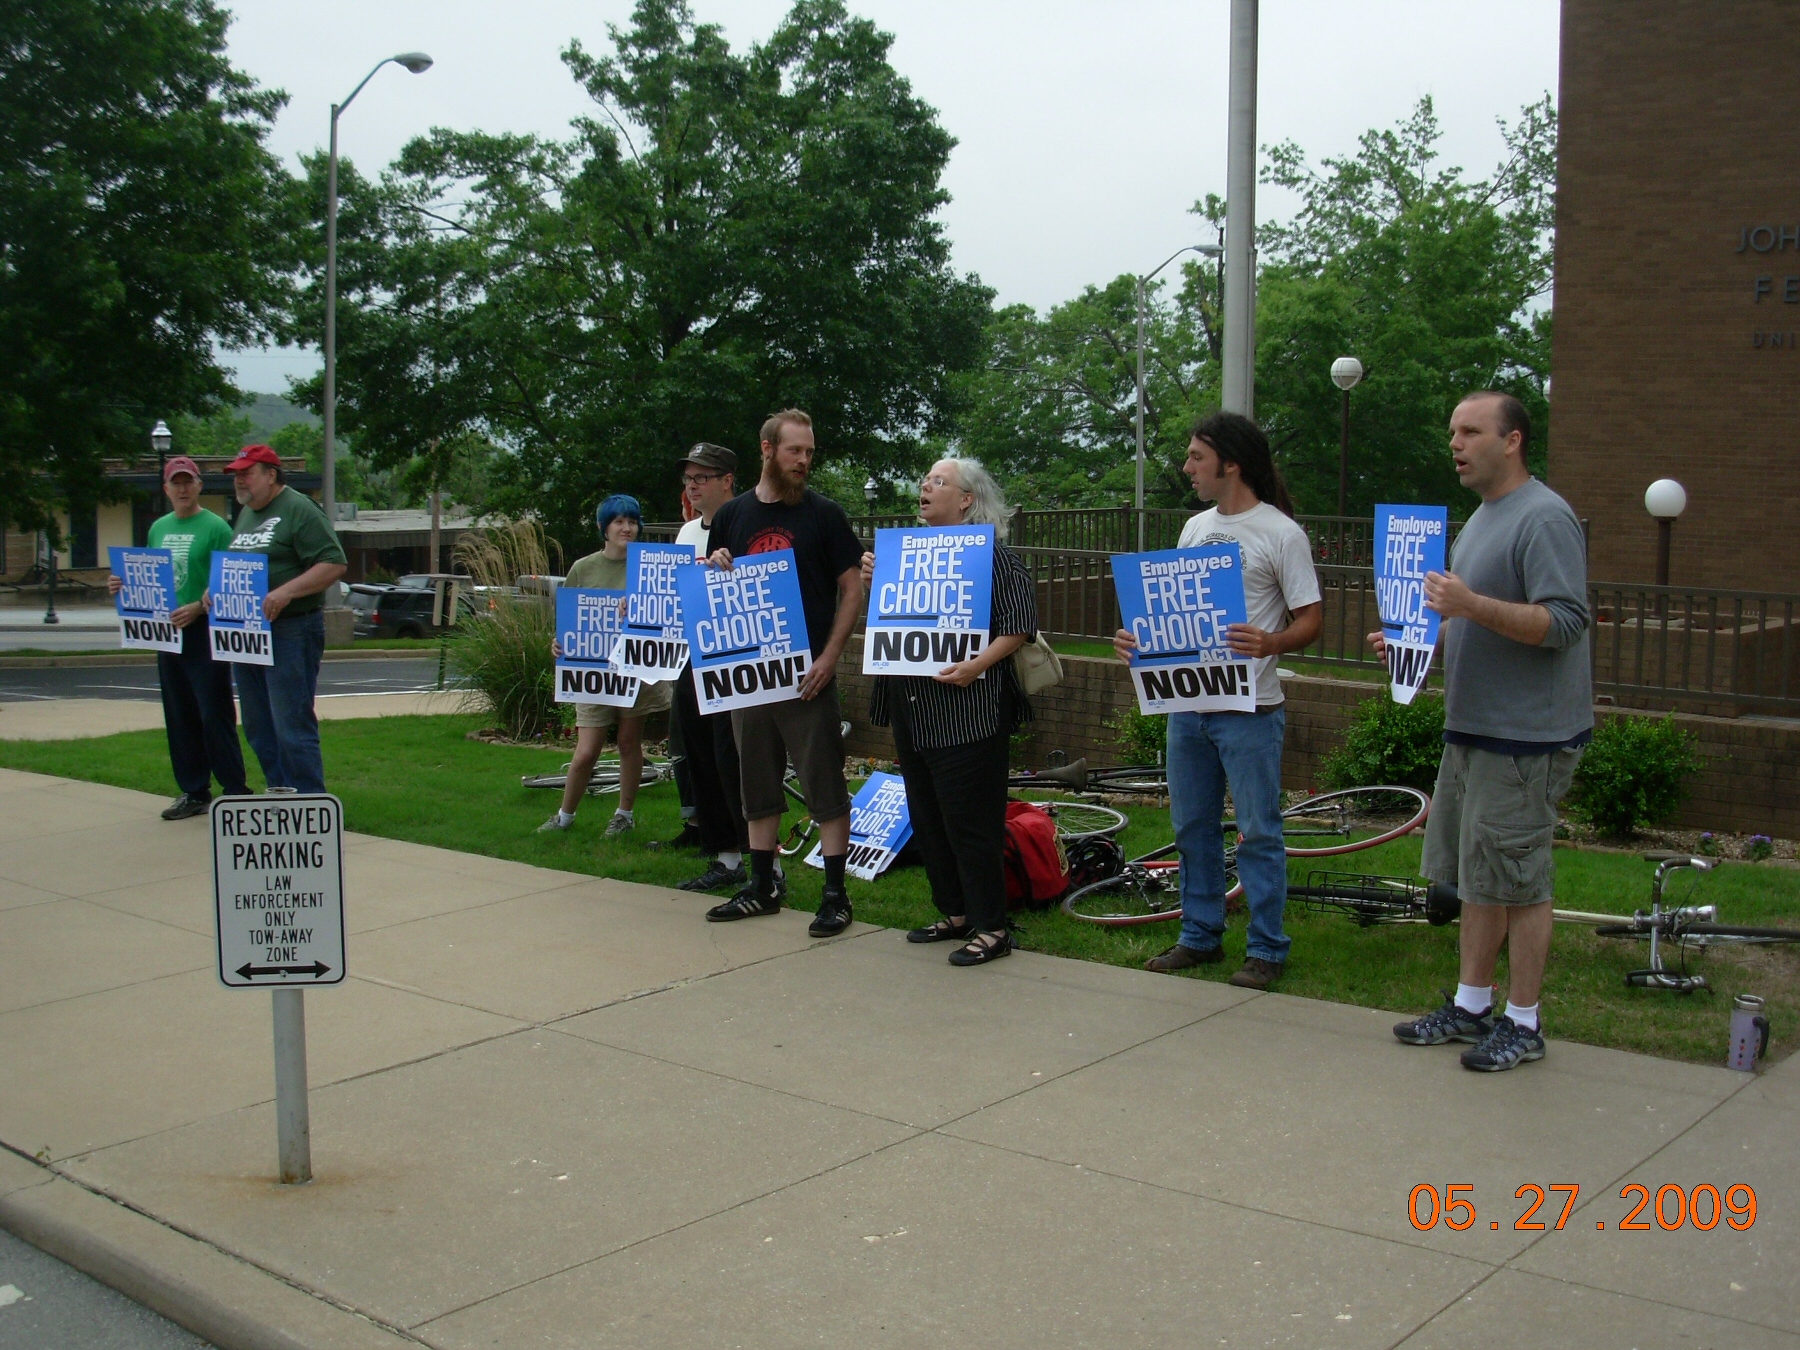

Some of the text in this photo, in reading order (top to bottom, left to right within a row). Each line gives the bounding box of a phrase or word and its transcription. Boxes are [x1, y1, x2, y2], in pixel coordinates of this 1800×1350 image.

[232, 531, 275, 546] AFSCME
[1387, 515, 1442, 538] Employee
[902, 533, 987, 550] Employee
[122, 552, 169, 566] Employee
[222, 557, 264, 571] Employee
[640, 550, 691, 567] Employee
[899, 547, 965, 581] FREE
[1139, 555, 1233, 578] Employee
[1384, 534, 1427, 579] FREE
[124, 563, 161, 587] FREE
[221, 568, 255, 595] FREE
[638, 563, 677, 595] FREE
[704, 559, 789, 584] Employee
[120, 584, 170, 611] CHOICE
[578, 594, 622, 608] Emplo
[706, 575, 774, 617] FREE
[878, 580, 974, 615] CHOICE
[1142, 571, 1214, 615] FREE
[1377, 576, 1429, 626] CHOICE
[213, 593, 262, 620] CHOICE
[627, 593, 684, 626] CHOICE
[123, 619, 179, 643] NOW!
[244, 620, 263, 631] ACT
[661, 626, 684, 639] ACT
[696, 607, 791, 653] CHOICE
[936, 615, 973, 629] ACT
[1132, 609, 1228, 653] CHOICE
[214, 629, 269, 655] NOW!
[872, 631, 982, 663] NOW!
[1401, 625, 1428, 645] ACT
[624, 639, 689, 669] NOW!
[760, 640, 792, 658] ACT
[1199, 649, 1235, 663] ACT
[561, 669, 637, 697] NOW!
[702, 655, 806, 701] NOW!
[1139, 664, 1250, 701] NOW!
[865, 788, 907, 815] FREE
[222, 807, 332, 836] RESERVED
[865, 835, 888, 847] ACT
[233, 841, 324, 870] PARKING
[265, 875, 292, 891] LAW
[235, 892, 324, 910] ENFORCEMENT
[265, 911, 296, 927] ONLY
[249, 928, 313, 945] TOW-AWAY
[266, 946, 298, 962] ZONE
